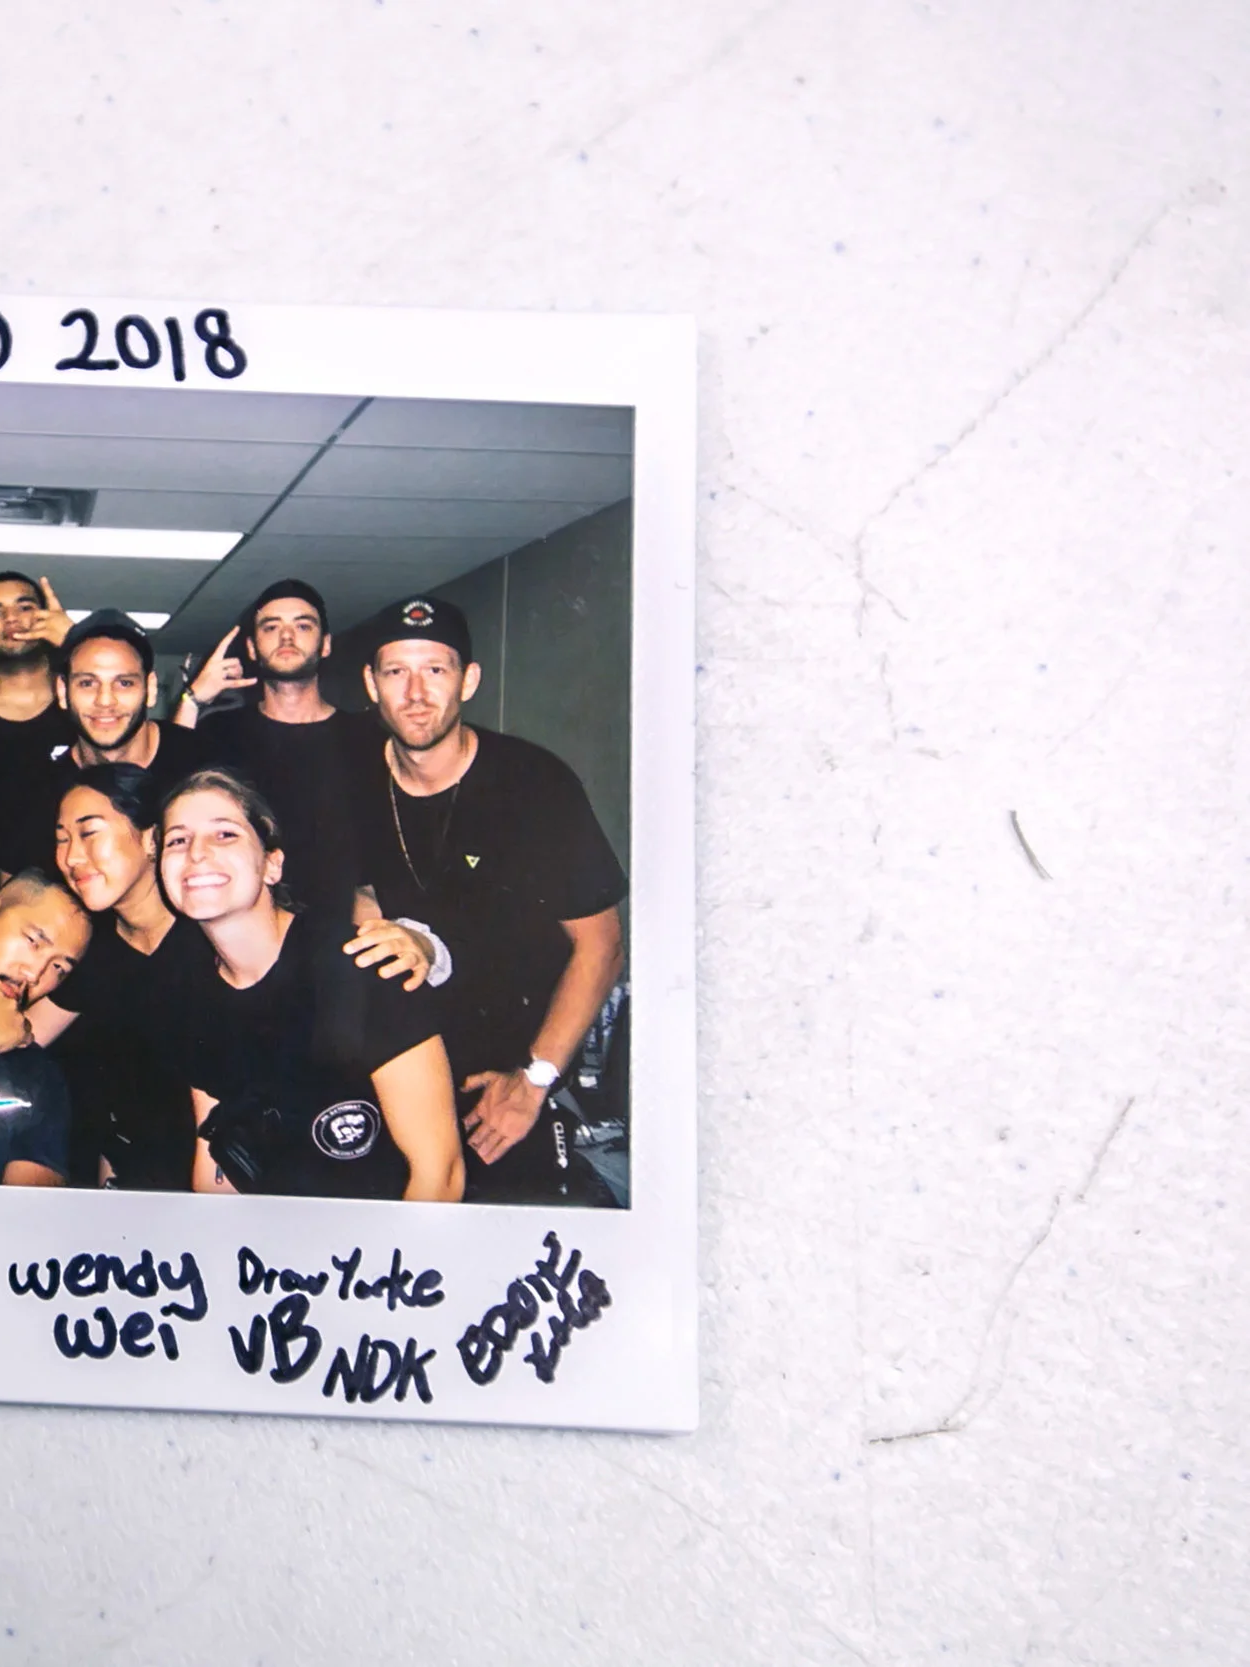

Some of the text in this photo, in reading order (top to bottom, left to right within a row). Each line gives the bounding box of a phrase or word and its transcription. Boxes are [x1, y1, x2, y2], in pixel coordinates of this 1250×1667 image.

[55, 308, 248, 383] 2018
[223, 1292, 323, 1384] VB
[322, 1333, 438, 1404] NDK
